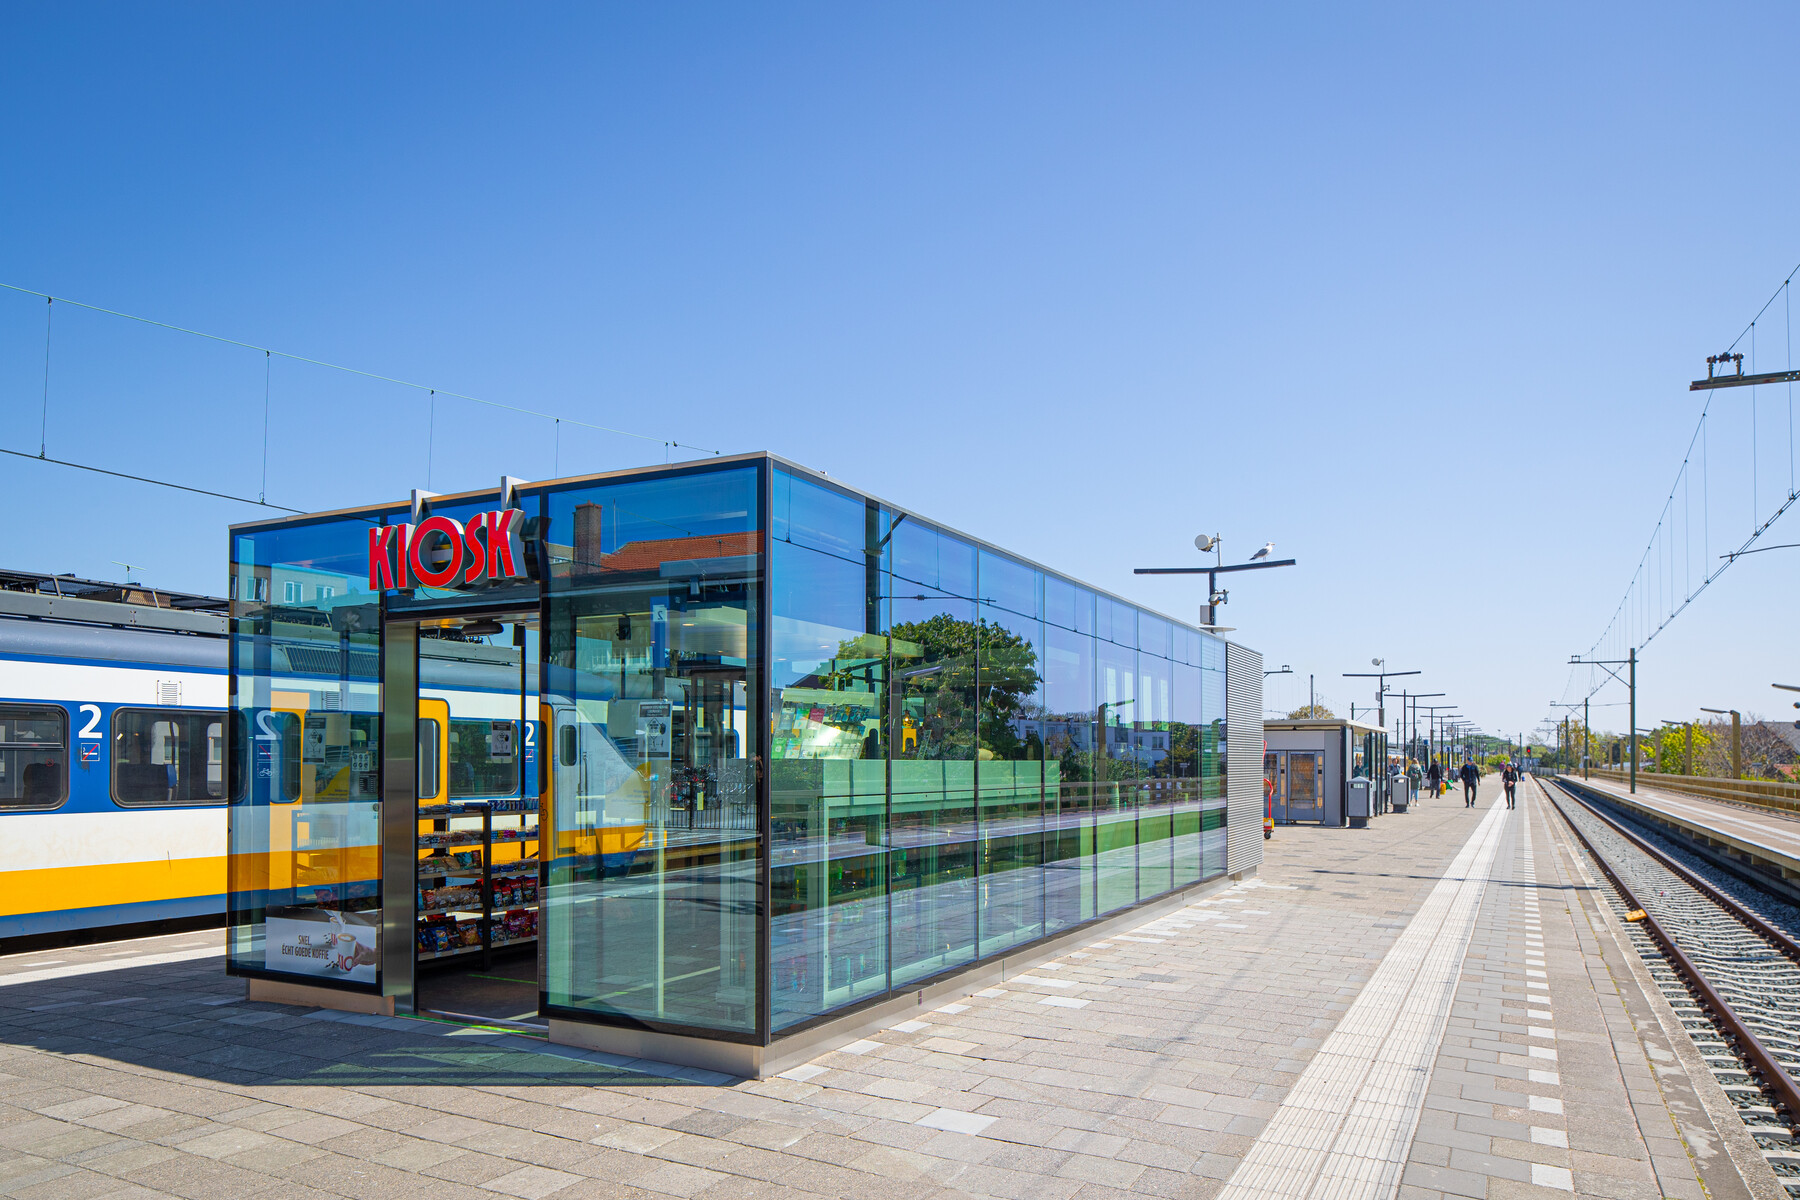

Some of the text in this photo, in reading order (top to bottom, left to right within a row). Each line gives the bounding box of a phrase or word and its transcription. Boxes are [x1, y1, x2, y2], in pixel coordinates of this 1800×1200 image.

[369, 508, 522, 591] KIOSK
[78, 703, 103, 739] 2
[525, 721, 535, 747] 2
[294, 946, 312, 958] GOEDE
[311, 948, 329, 960] KOFFIE
[298, 934, 312, 946] SNEL,
